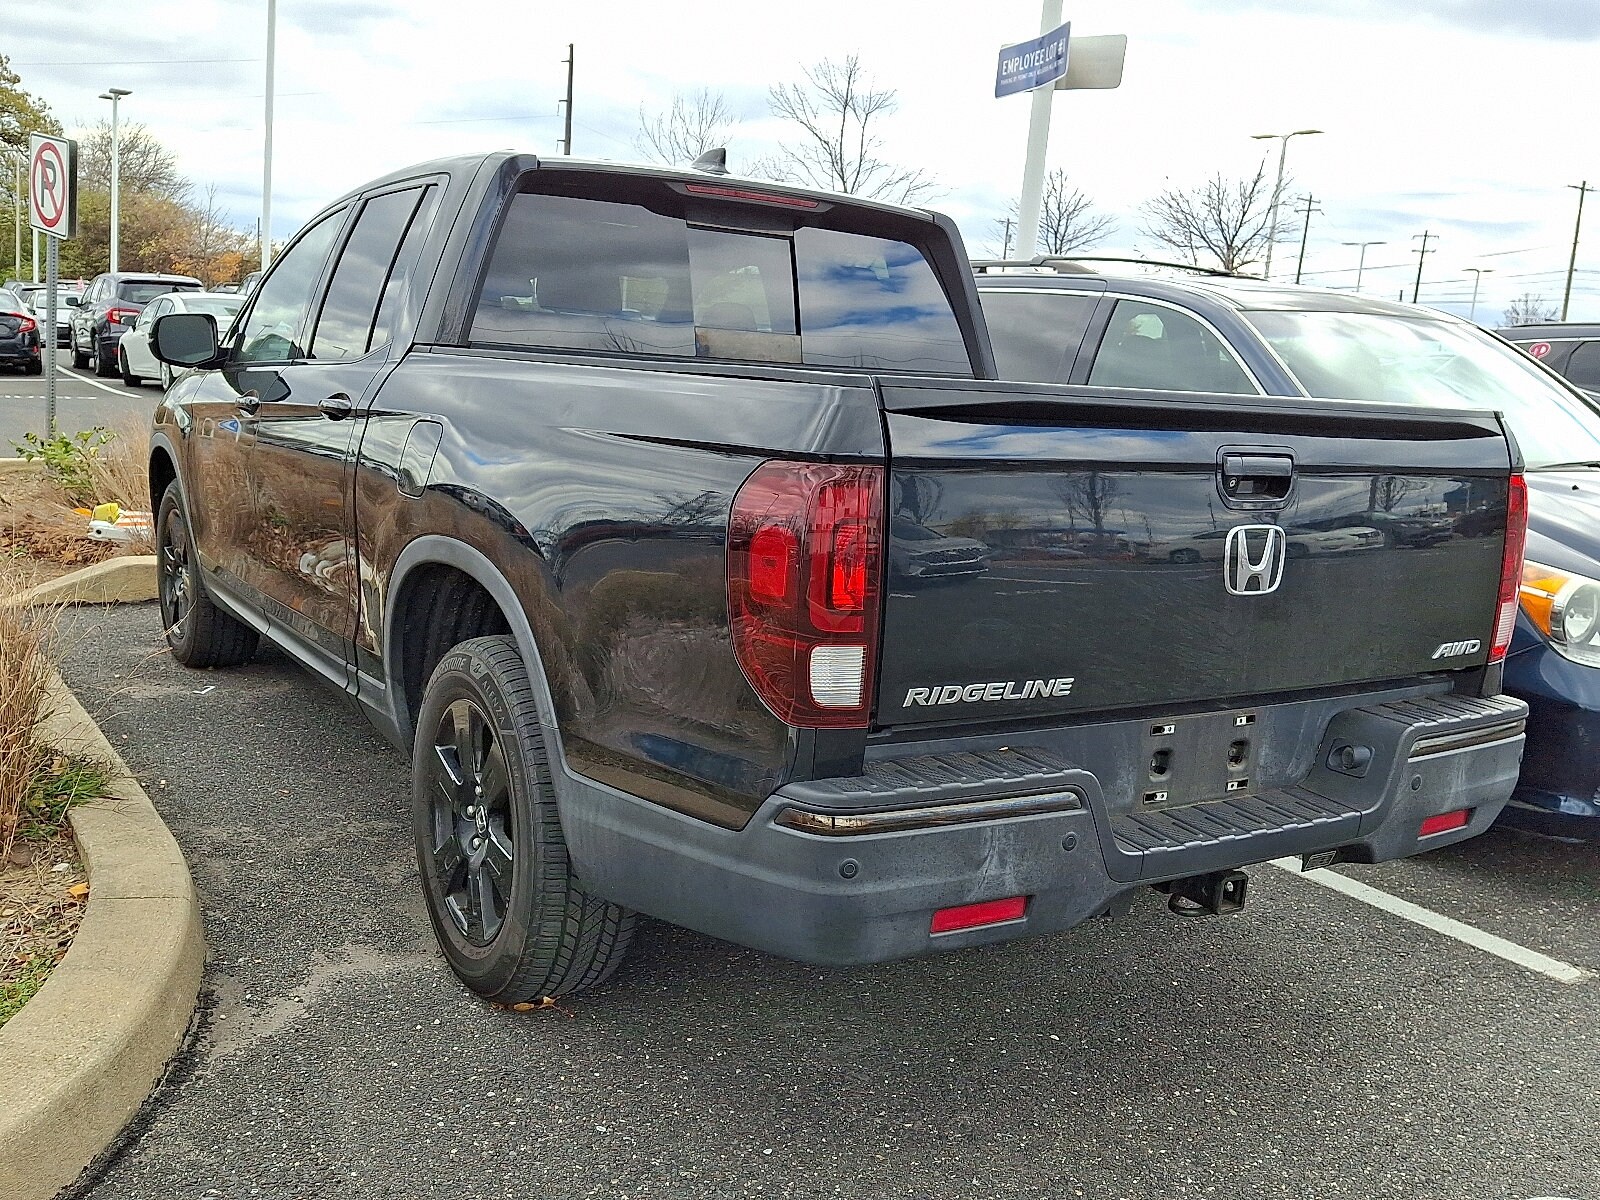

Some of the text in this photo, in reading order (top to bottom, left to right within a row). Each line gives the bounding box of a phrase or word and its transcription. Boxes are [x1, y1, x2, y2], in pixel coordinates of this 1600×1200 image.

[1002, 48, 1045, 75] EMPLOYEE
[1045, 42, 1057, 61] LOT
[1431, 639, 1481, 660] AWD
[902, 677, 1075, 708] RIDGELINE
